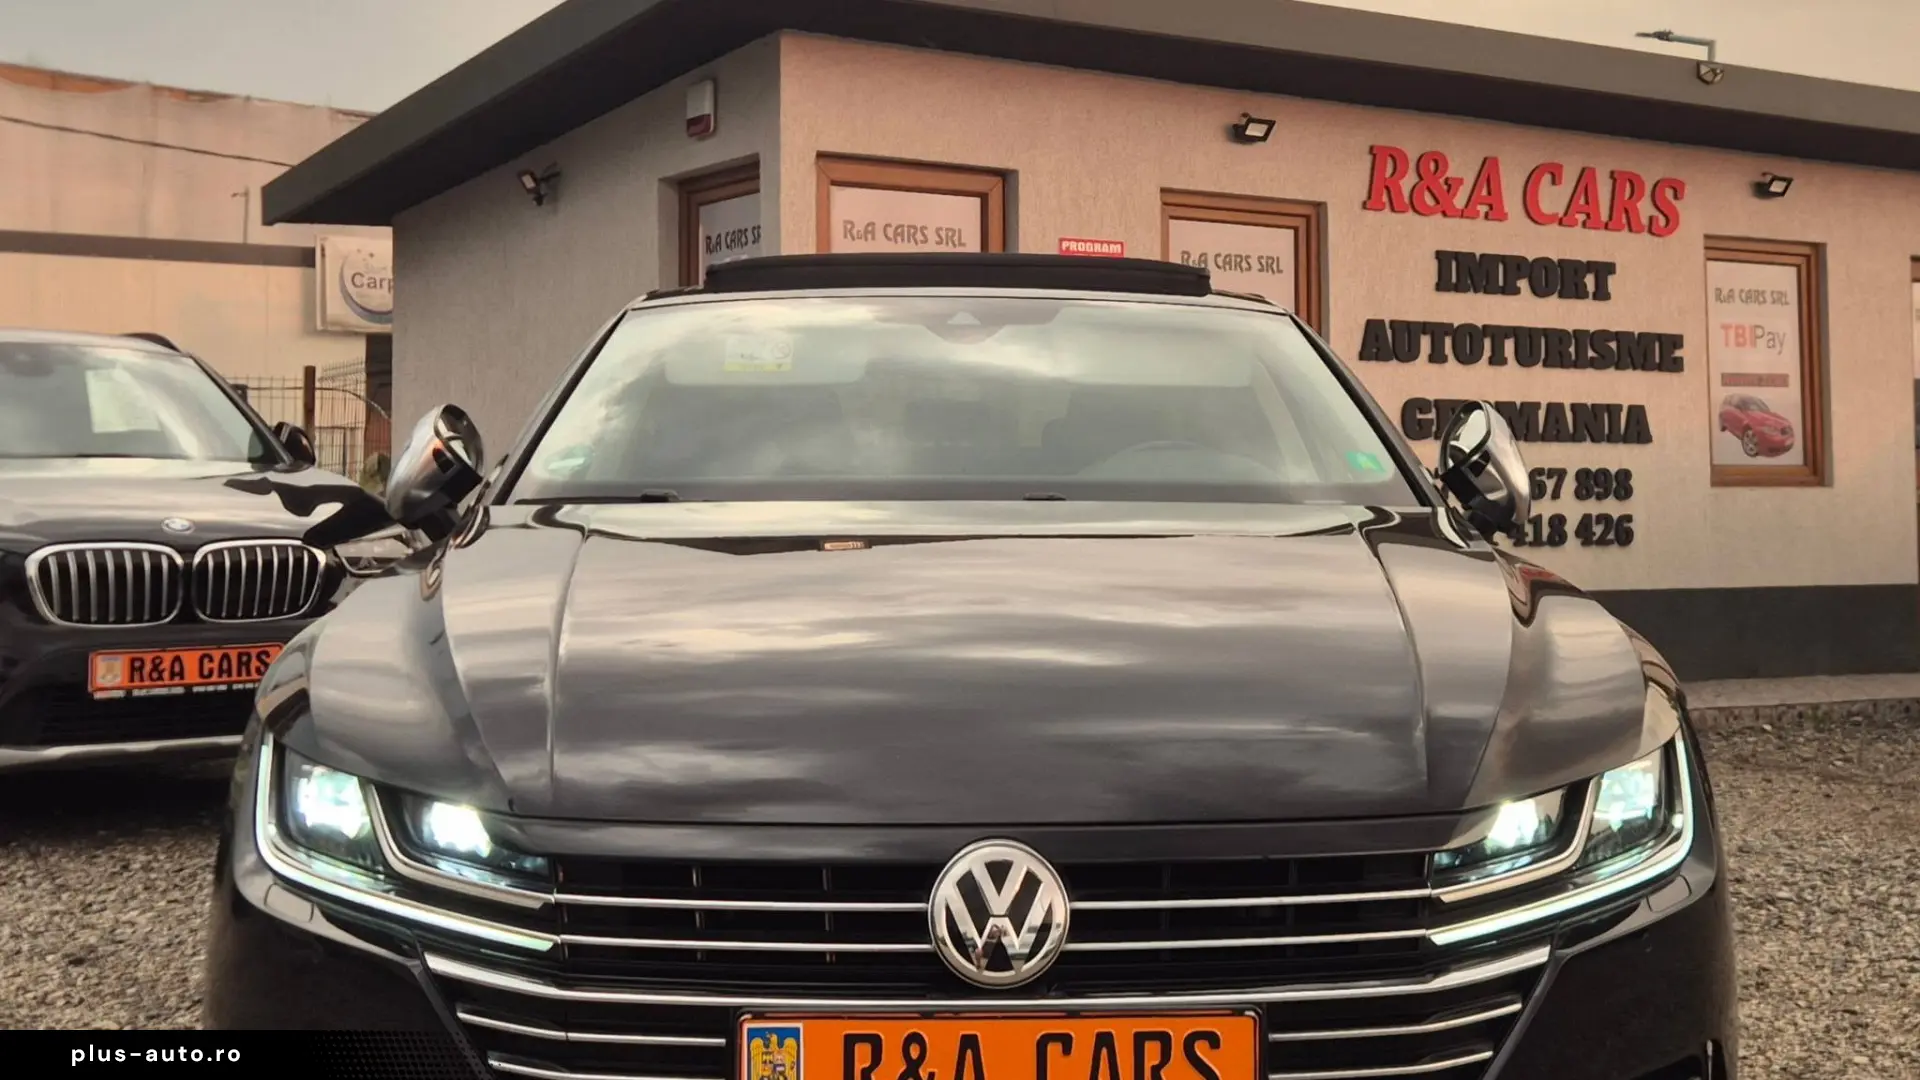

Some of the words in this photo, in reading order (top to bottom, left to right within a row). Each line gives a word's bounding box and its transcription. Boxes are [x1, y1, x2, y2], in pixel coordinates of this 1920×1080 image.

[1363, 144, 1508, 221] R&A
[1524, 162, 1686, 237] CARS
[725, 227, 749, 251] CARS
[883, 223, 928, 246] CARS
[935, 226, 967, 248] SRL
[1062, 240, 1122, 254] PROGRAM
[1214, 252, 1253, 274] CARS
[1257, 255, 1284, 275] SRL
[1435, 250, 1616, 301] IMPORT
[1738, 288, 1768, 306] CARS
[1770, 289, 1790, 307] SRL
[1359, 318, 1685, 373] AUTOTURISME
[1574, 467, 1634, 501] 898
[1574, 513, 1635, 547] 426
[128, 655, 185, 683] R&A
[199, 650, 271, 680] CARS
[842, 1031, 986, 1080] R&A
[1035, 1030, 1222, 1080] CARS
